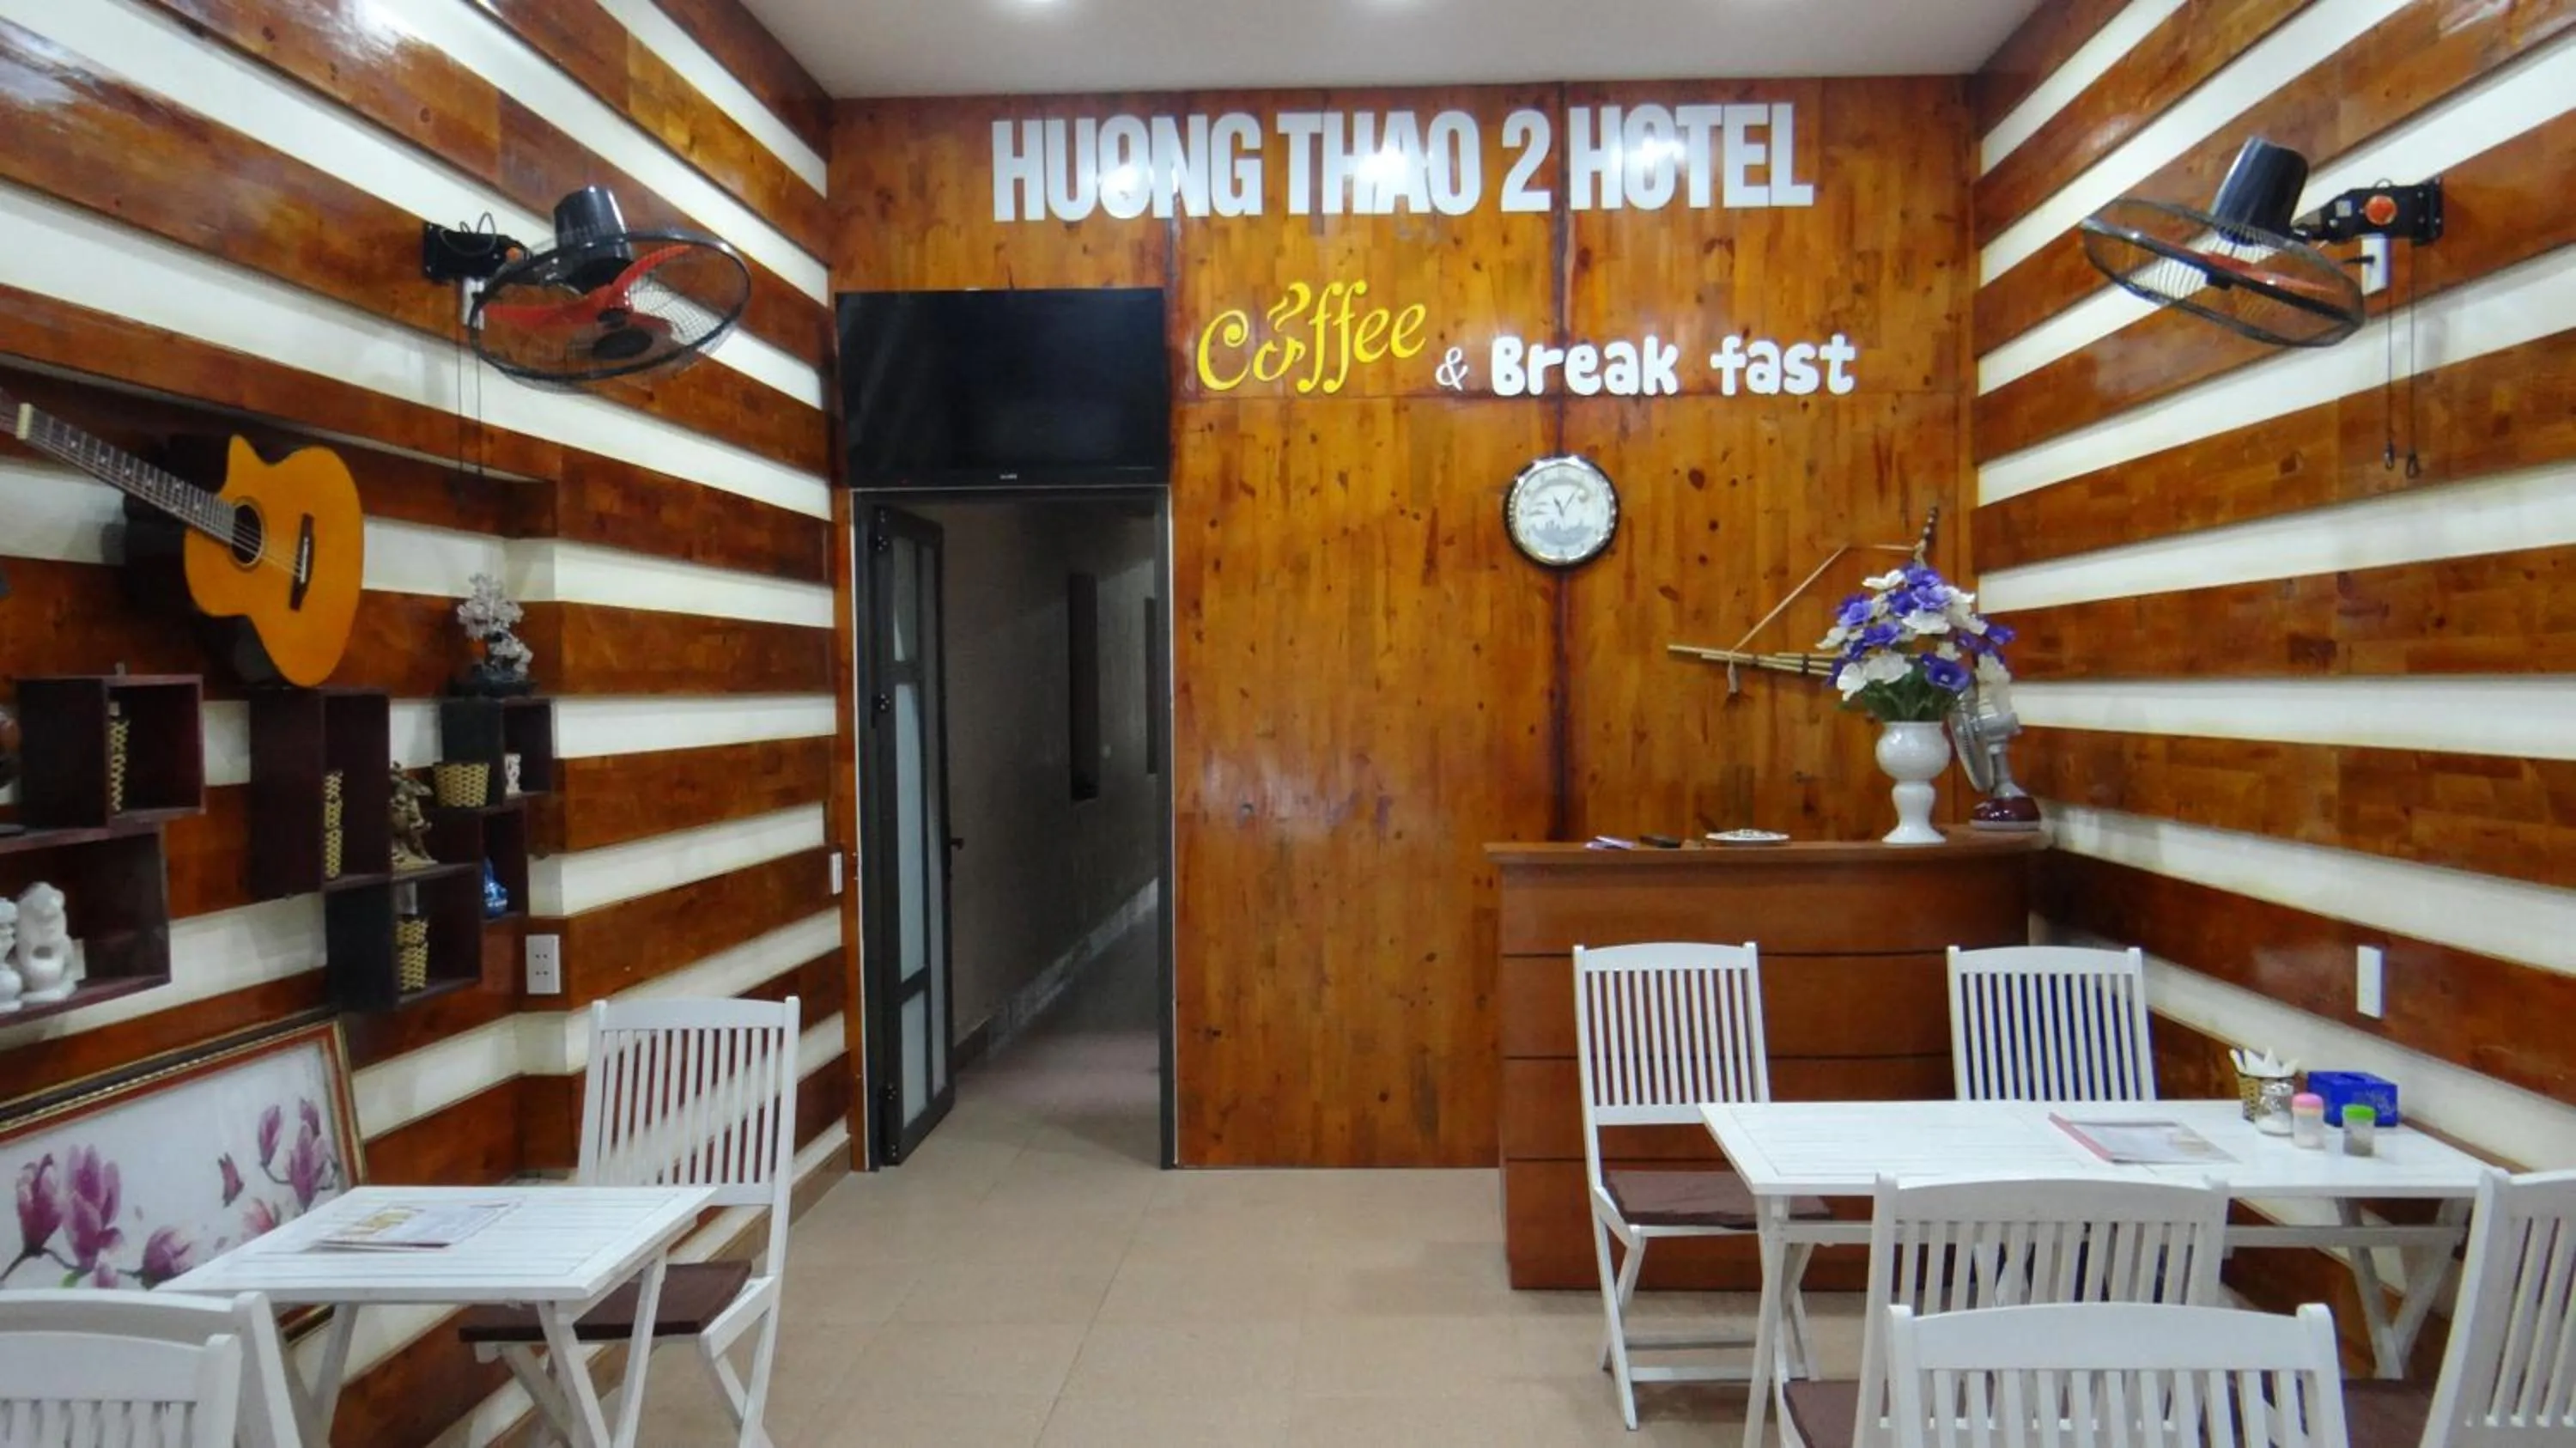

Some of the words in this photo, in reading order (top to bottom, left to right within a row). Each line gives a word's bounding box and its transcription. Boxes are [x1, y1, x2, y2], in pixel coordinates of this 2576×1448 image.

[992, 113, 1263, 222] HUONG
[1277, 109, 1480, 216] THAO
[1501, 111, 1552, 213] 2
[1569, 102, 1814, 210] HOTEL
[1196, 281, 1427, 393] Coffee
[1436, 345, 1467, 391] &
[1490, 334, 1679, 397] Break
[1710, 333, 1856, 396] fast
